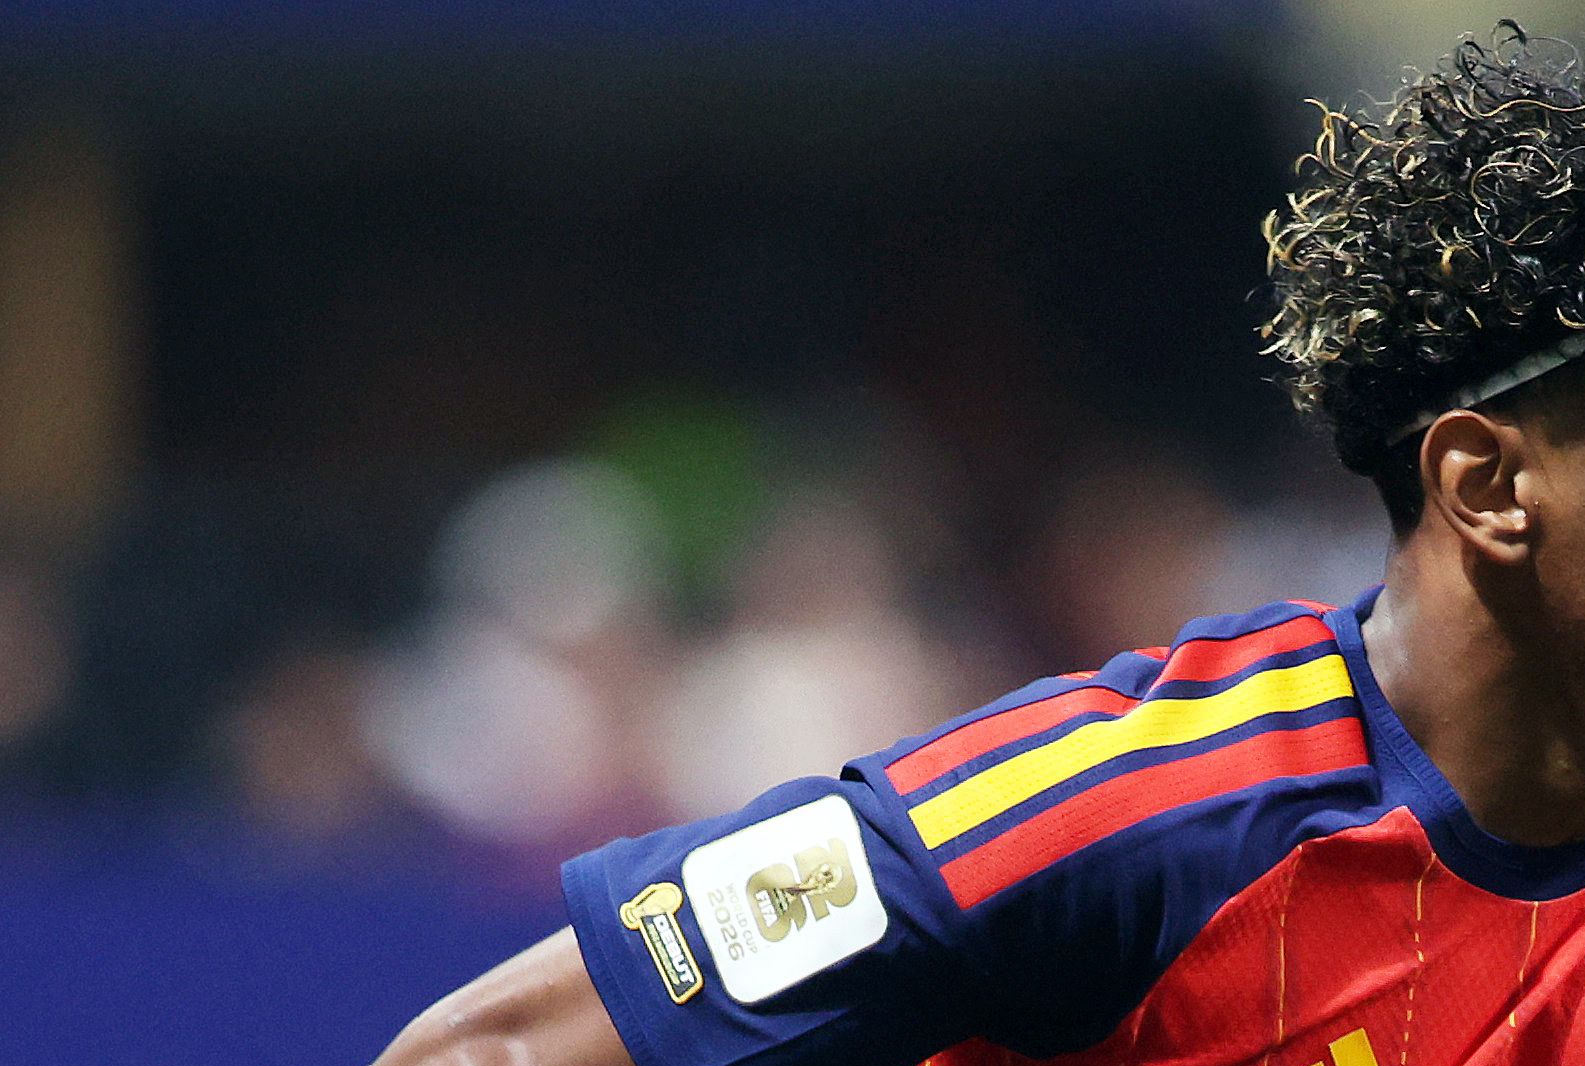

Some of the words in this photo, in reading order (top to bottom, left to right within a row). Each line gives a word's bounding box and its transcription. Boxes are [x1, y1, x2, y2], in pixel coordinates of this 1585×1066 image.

[707, 888, 745, 961] 2026
[755, 889, 779, 928] FIFA
[652, 916, 695, 984] DEBUT
[742, 929, 759, 954] CUP
